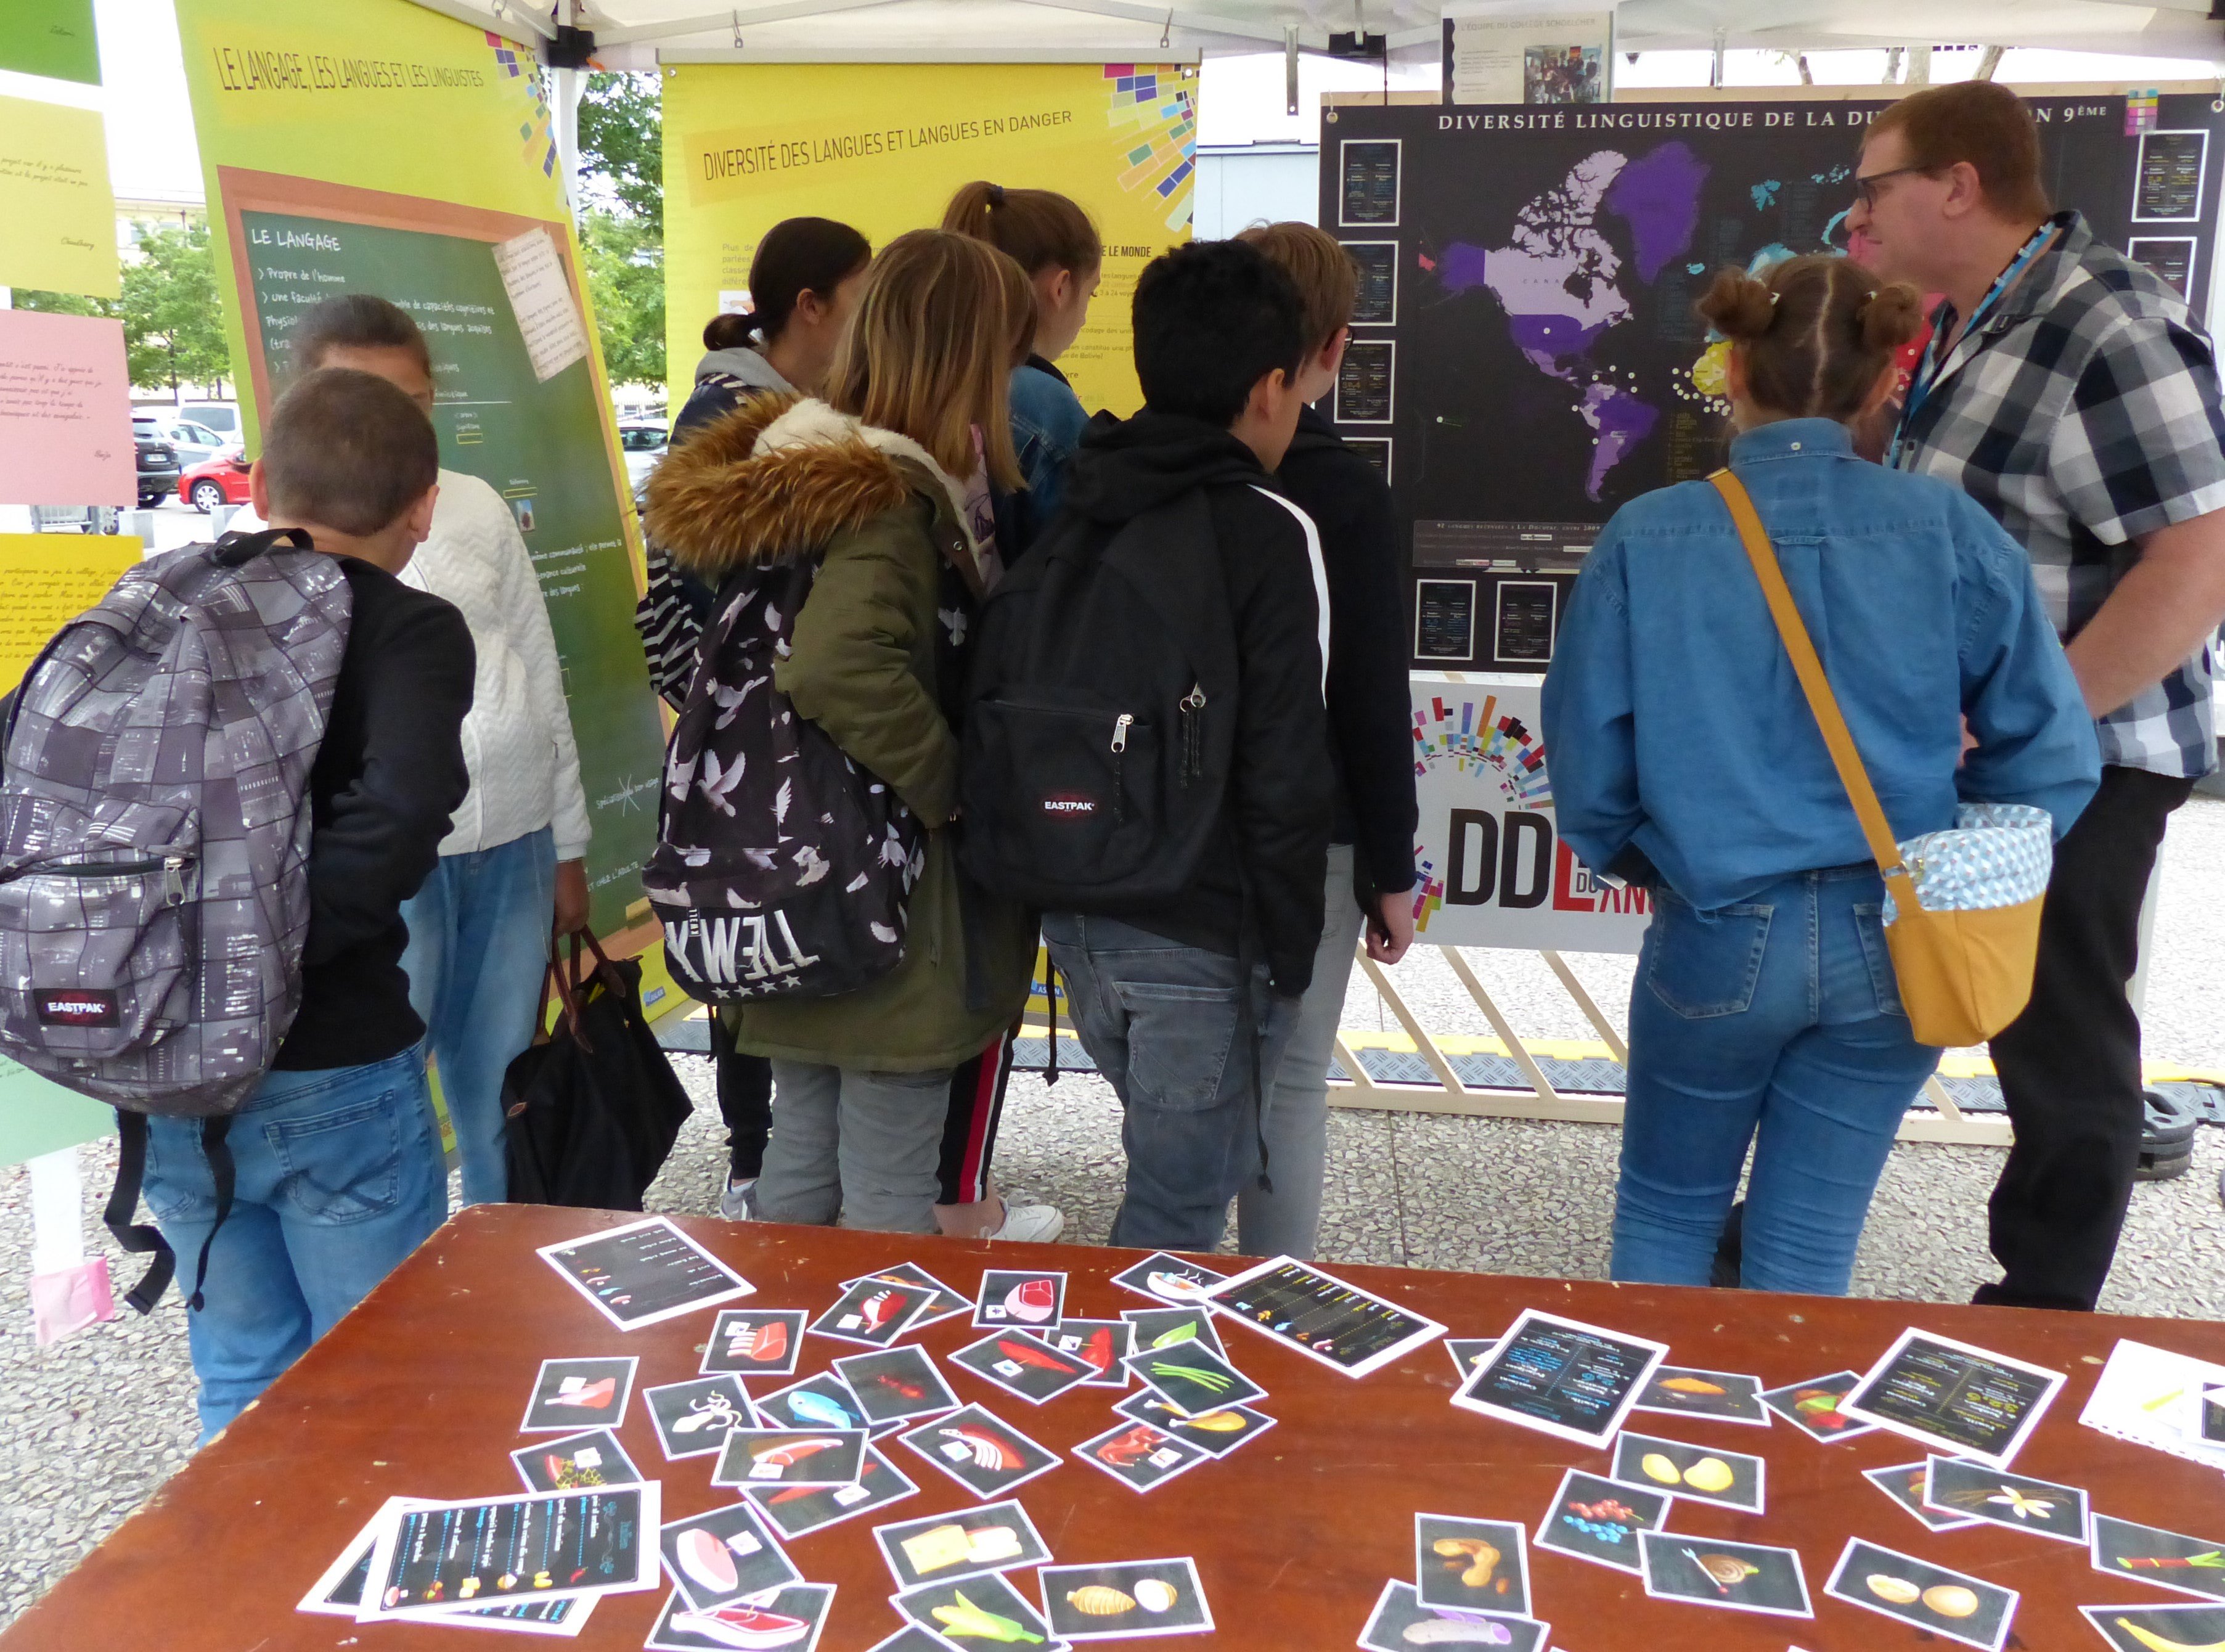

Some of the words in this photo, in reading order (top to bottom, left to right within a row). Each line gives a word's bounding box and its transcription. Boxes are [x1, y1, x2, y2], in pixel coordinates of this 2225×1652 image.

[213, 47, 241, 90] LE
[237, 49, 312, 92] LANGAGE,
[308, 55, 336, 88] LES
[333, 58, 393, 88] LANGUES
[390, 62, 406, 86] ET
[405, 65, 427, 86] LES
[427, 67, 484, 86] LINGUISTES
[1439, 111, 1565, 129] DIVERSITÉ
[1576, 112, 1753, 129] LINGUISTIQUE
[1765, 112, 1794, 126] DE
[1807, 112, 1835, 126] LA
[704, 139, 777, 180] DIVERSITÉ
[781, 141, 810, 168] DES
[814, 133, 883, 163] LANGUES
[887, 130, 904, 151] ET
[909, 121, 979, 148] LANGUES
[984, 118, 1004, 136] EN
[1010, 110, 1072, 132] DANGER
[251, 228, 272, 245] LE
[277, 230, 341, 251] LANGAGE
[1109, 246, 1119, 256] LE
[1121, 246, 1151, 258] MONDE
[300, 269, 310, 280] de
[1045, 801, 1092, 811] EASTPAK
[47, 1002, 104, 1013] EASTPAK
